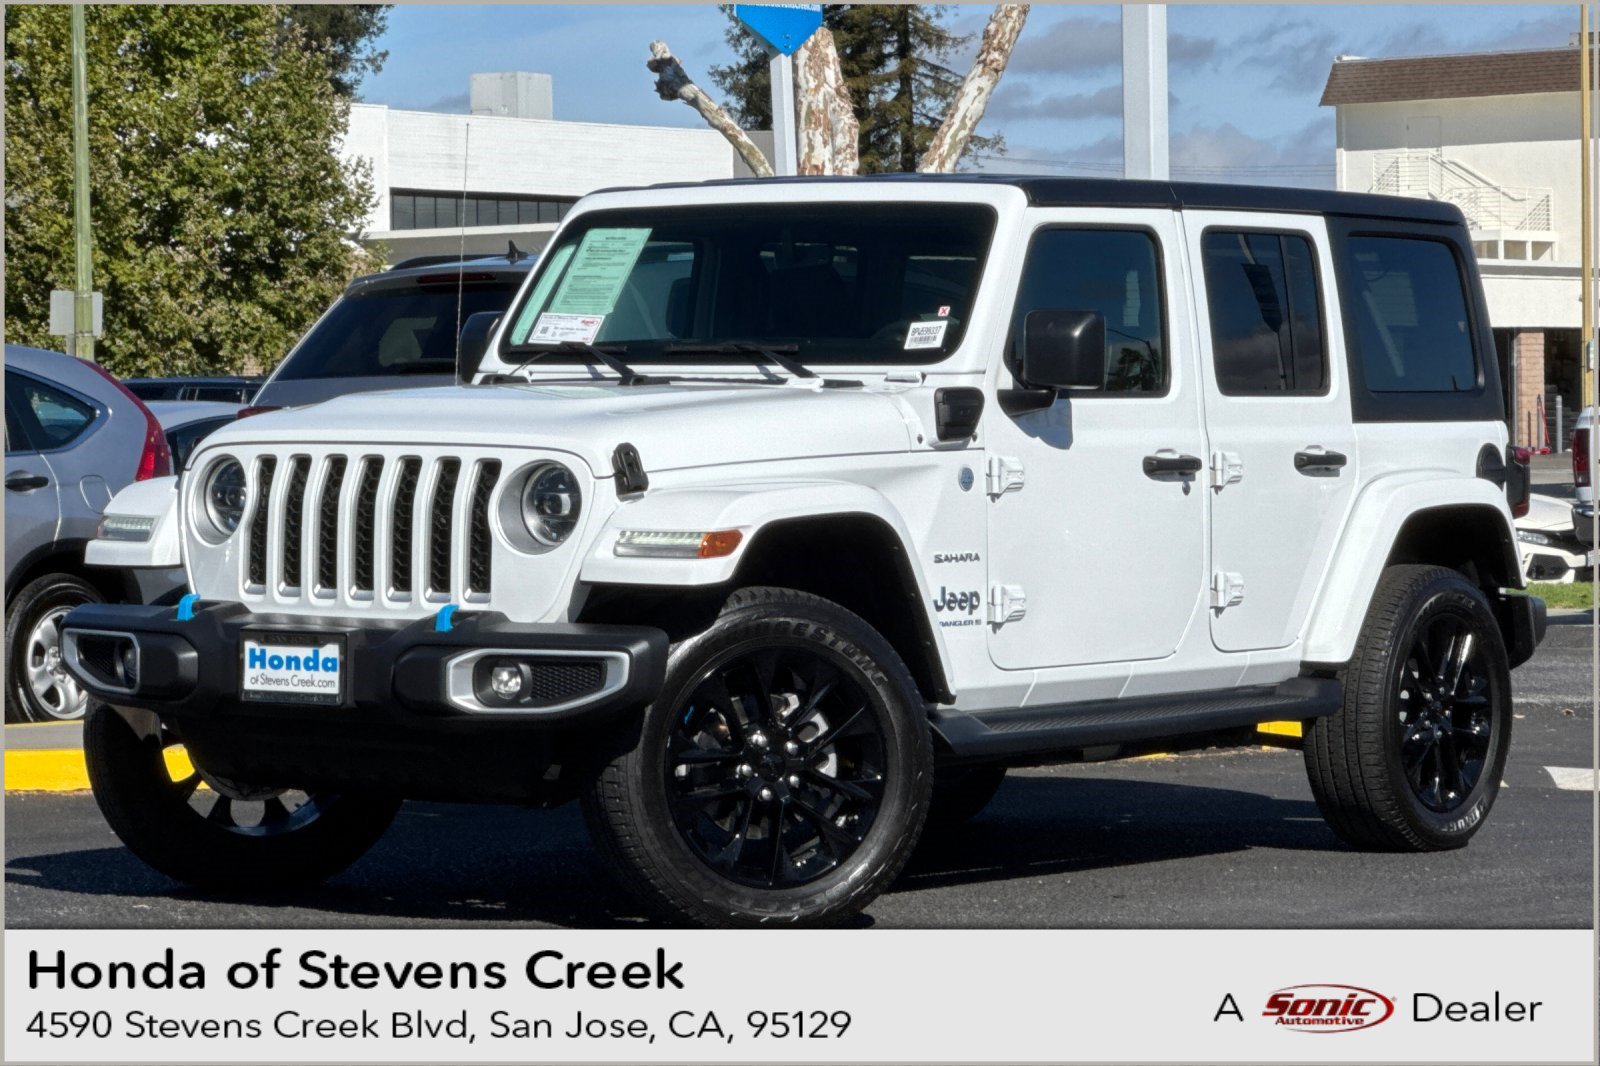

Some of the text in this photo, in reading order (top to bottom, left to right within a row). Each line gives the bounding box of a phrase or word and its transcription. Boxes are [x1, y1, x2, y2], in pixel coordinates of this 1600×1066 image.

[934, 553, 981, 564] SAHARA
[933, 586, 980, 615] Jeep
[249, 648, 338, 672] Honda
[250, 673, 336, 688] of Stevens Creek.com
